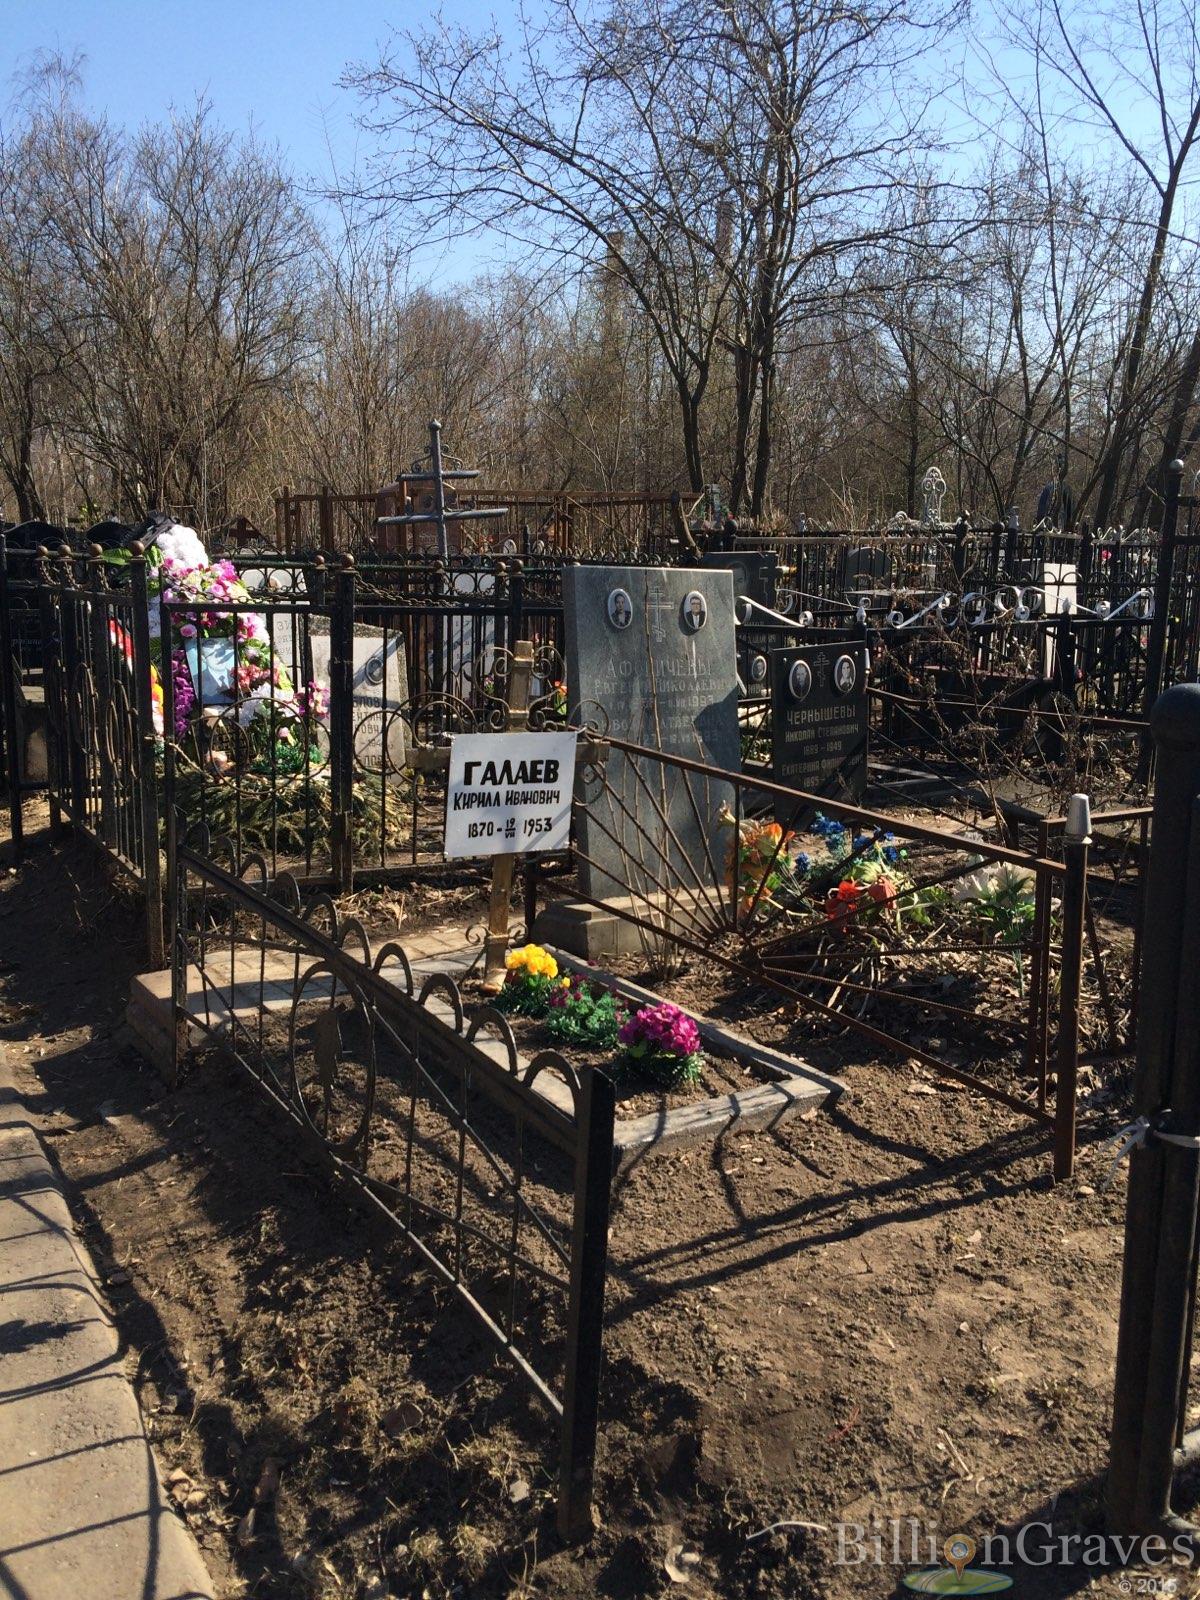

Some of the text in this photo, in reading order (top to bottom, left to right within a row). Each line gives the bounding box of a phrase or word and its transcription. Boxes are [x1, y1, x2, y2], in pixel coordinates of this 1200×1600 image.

[786, 704, 856, 725] ЧЕРНЫШЕВЫ
[463, 759, 560, 786] ГАЛАЕВ
[453, 789, 560, 811] КИРИЛЛ ИВАНОВИЧ
[468, 821, 494, 838] 1870
[523, 817, 552, 837] 1953
